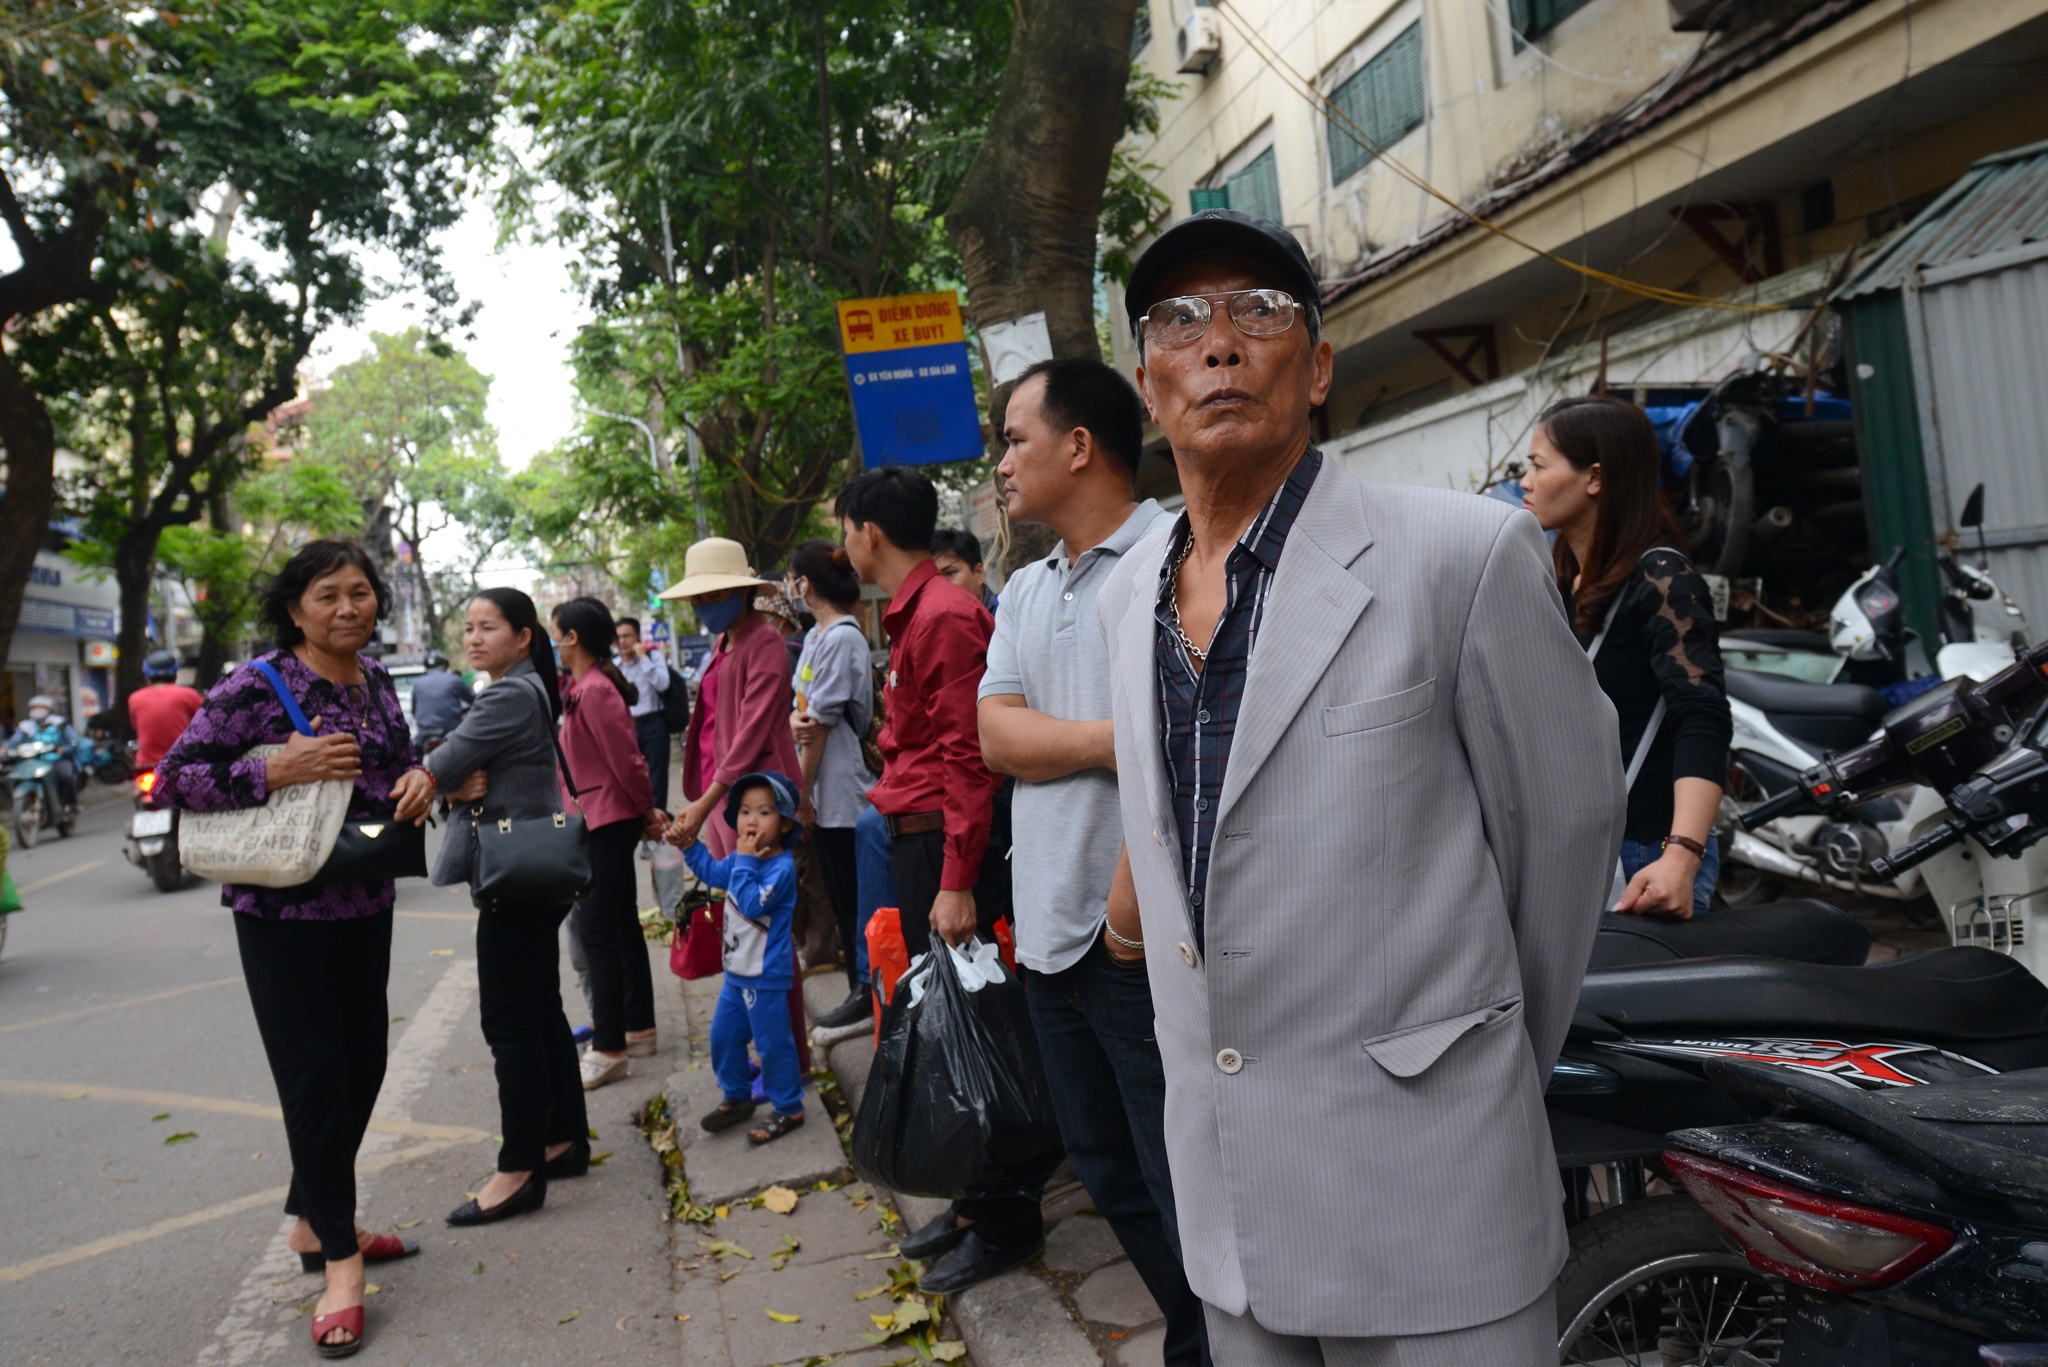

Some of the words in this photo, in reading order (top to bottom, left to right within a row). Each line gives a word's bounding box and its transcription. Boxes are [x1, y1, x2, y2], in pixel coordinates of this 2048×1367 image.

[892, 328, 910, 343] XE
[912, 321, 945, 341] BUÝT
[681, 649, 693, 666] P
